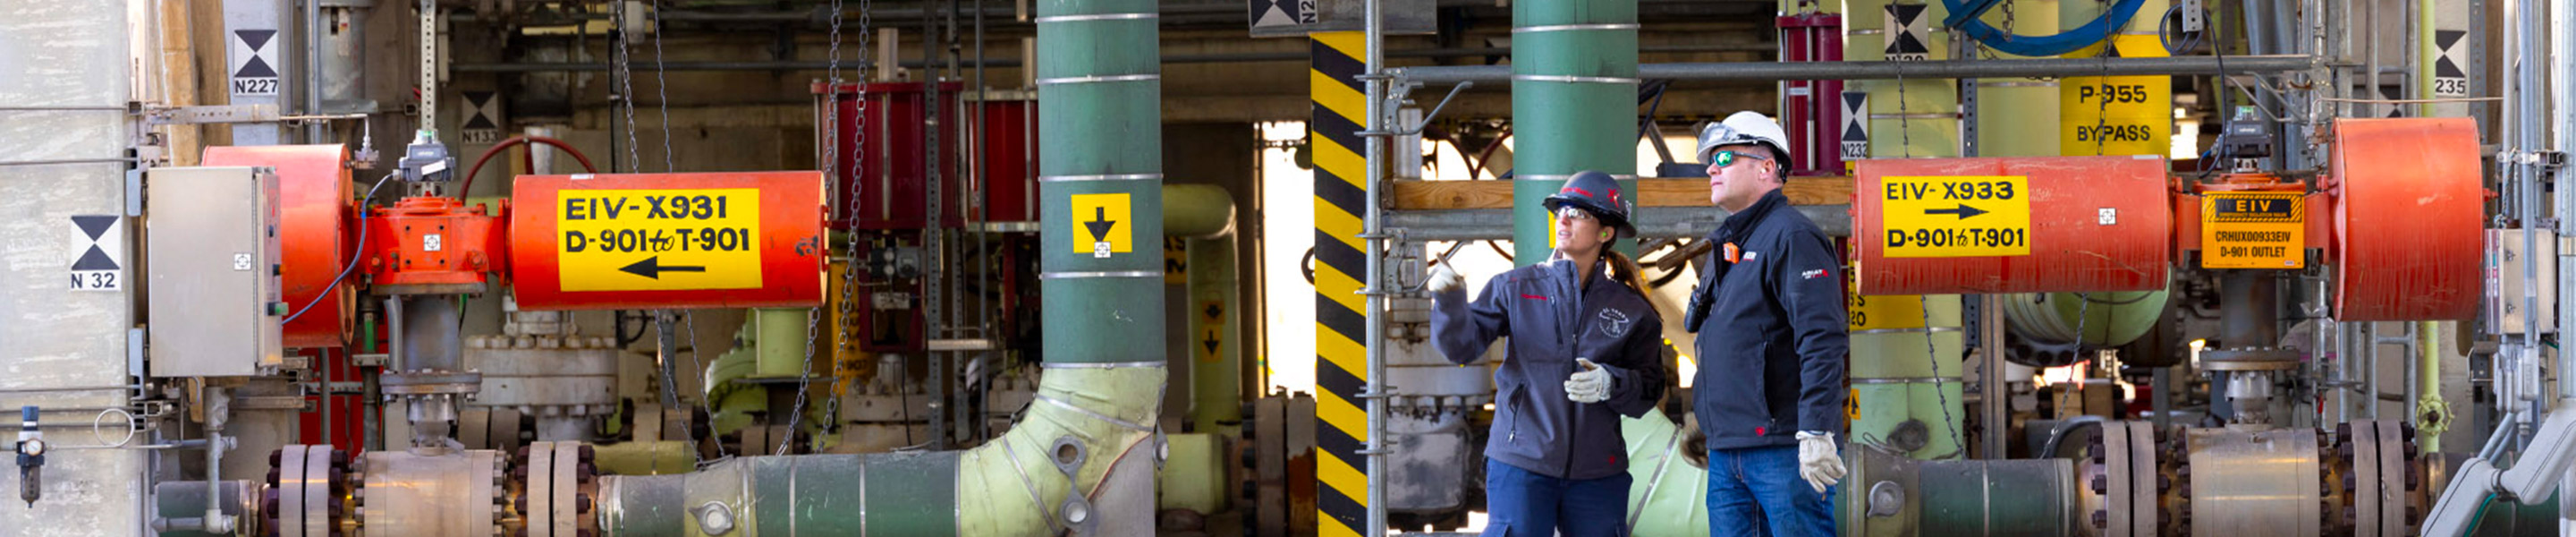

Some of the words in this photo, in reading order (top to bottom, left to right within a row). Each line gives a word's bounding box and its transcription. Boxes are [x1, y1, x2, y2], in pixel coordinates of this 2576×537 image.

[235, 79, 278, 94] N227
[2080, 85, 2148, 104] P-955
[462, 132, 499, 142] N133
[2077, 124, 2151, 141] BYPASS
[2236, 200, 2271, 212] EIV
[564, 229, 647, 252] D-901
[648, 229, 675, 252] to
[675, 227, 750, 252] T-901
[2216, 231, 2291, 243] CRHUX00933EIV
[2220, 246, 2249, 258] D-901
[2251, 246, 2286, 258] OUTLET
[71, 273, 83, 289] N
[91, 272, 116, 288] 32
